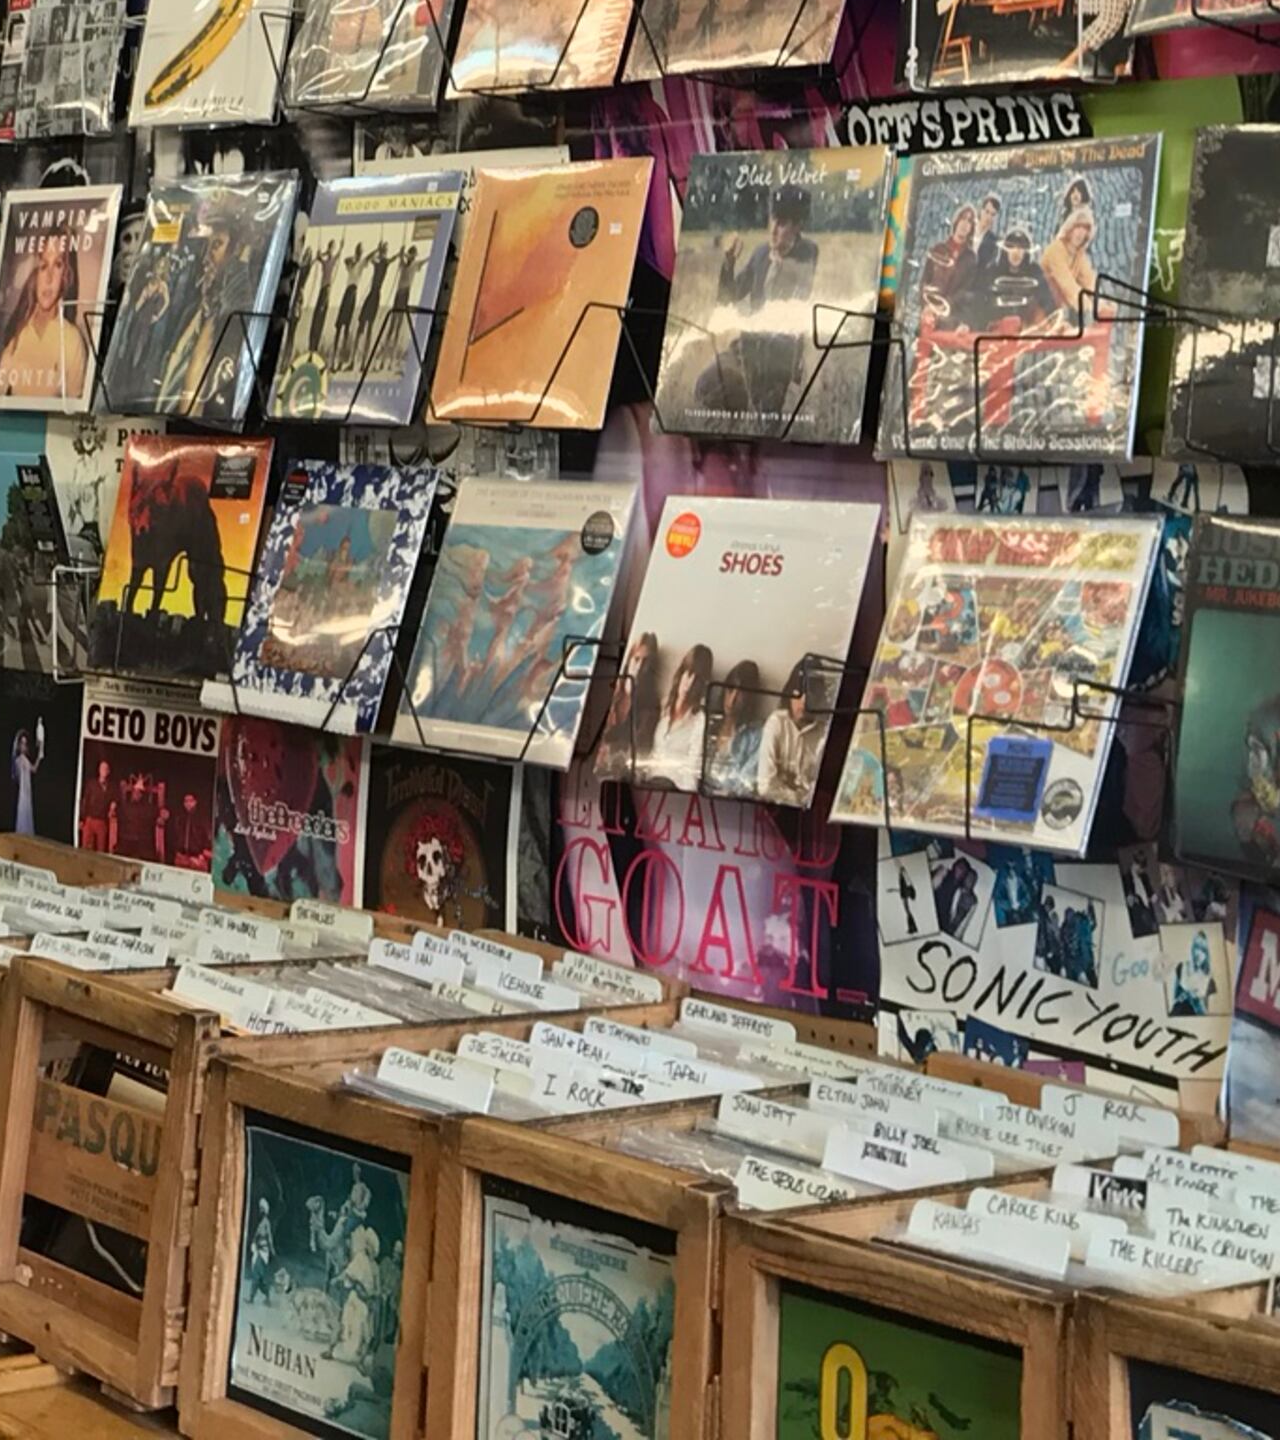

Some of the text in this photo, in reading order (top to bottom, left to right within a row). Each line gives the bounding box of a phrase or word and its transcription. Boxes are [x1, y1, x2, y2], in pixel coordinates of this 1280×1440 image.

[844, 92, 1082, 152] OFFSPRING
[1109, 144, 1145, 159] Dead
[735, 162, 827, 190] Blue Velvet
[386, 192, 455, 211] MANIACS
[14, 204, 100, 256] VAMPIRE WEEKEND
[718, 551, 784, 577] SHOES
[86, 702, 217, 751] GETO BOYS
[551, 837, 840, 1002] GOAT
[438, 982, 467, 1003] ROCK
[498, 971, 546, 1000] ICEHOUSE
[906, 938, 1228, 1074] SONIC YOUTH
[246, 1014, 271, 1031] HOT
[541, 1028, 564, 1048] JAN
[566, 1084, 607, 1107] ROCK
[817, 1085, 890, 1113] ELTON JOHN
[873, 1121, 906, 1146] BILLY
[998, 1132, 1021, 1146] LEE
[745, 1160, 769, 1180] THE
[932, 1211, 981, 1234] KANSAS
[987, 1195, 1080, 1230] CAROLE KING
[1166, 1208, 1192, 1230] The
[1168, 1230, 1207, 1252] KING
[1109, 1239, 1203, 1277] THE KILLERS
[246, 1322, 318, 1380] NUBIAN
